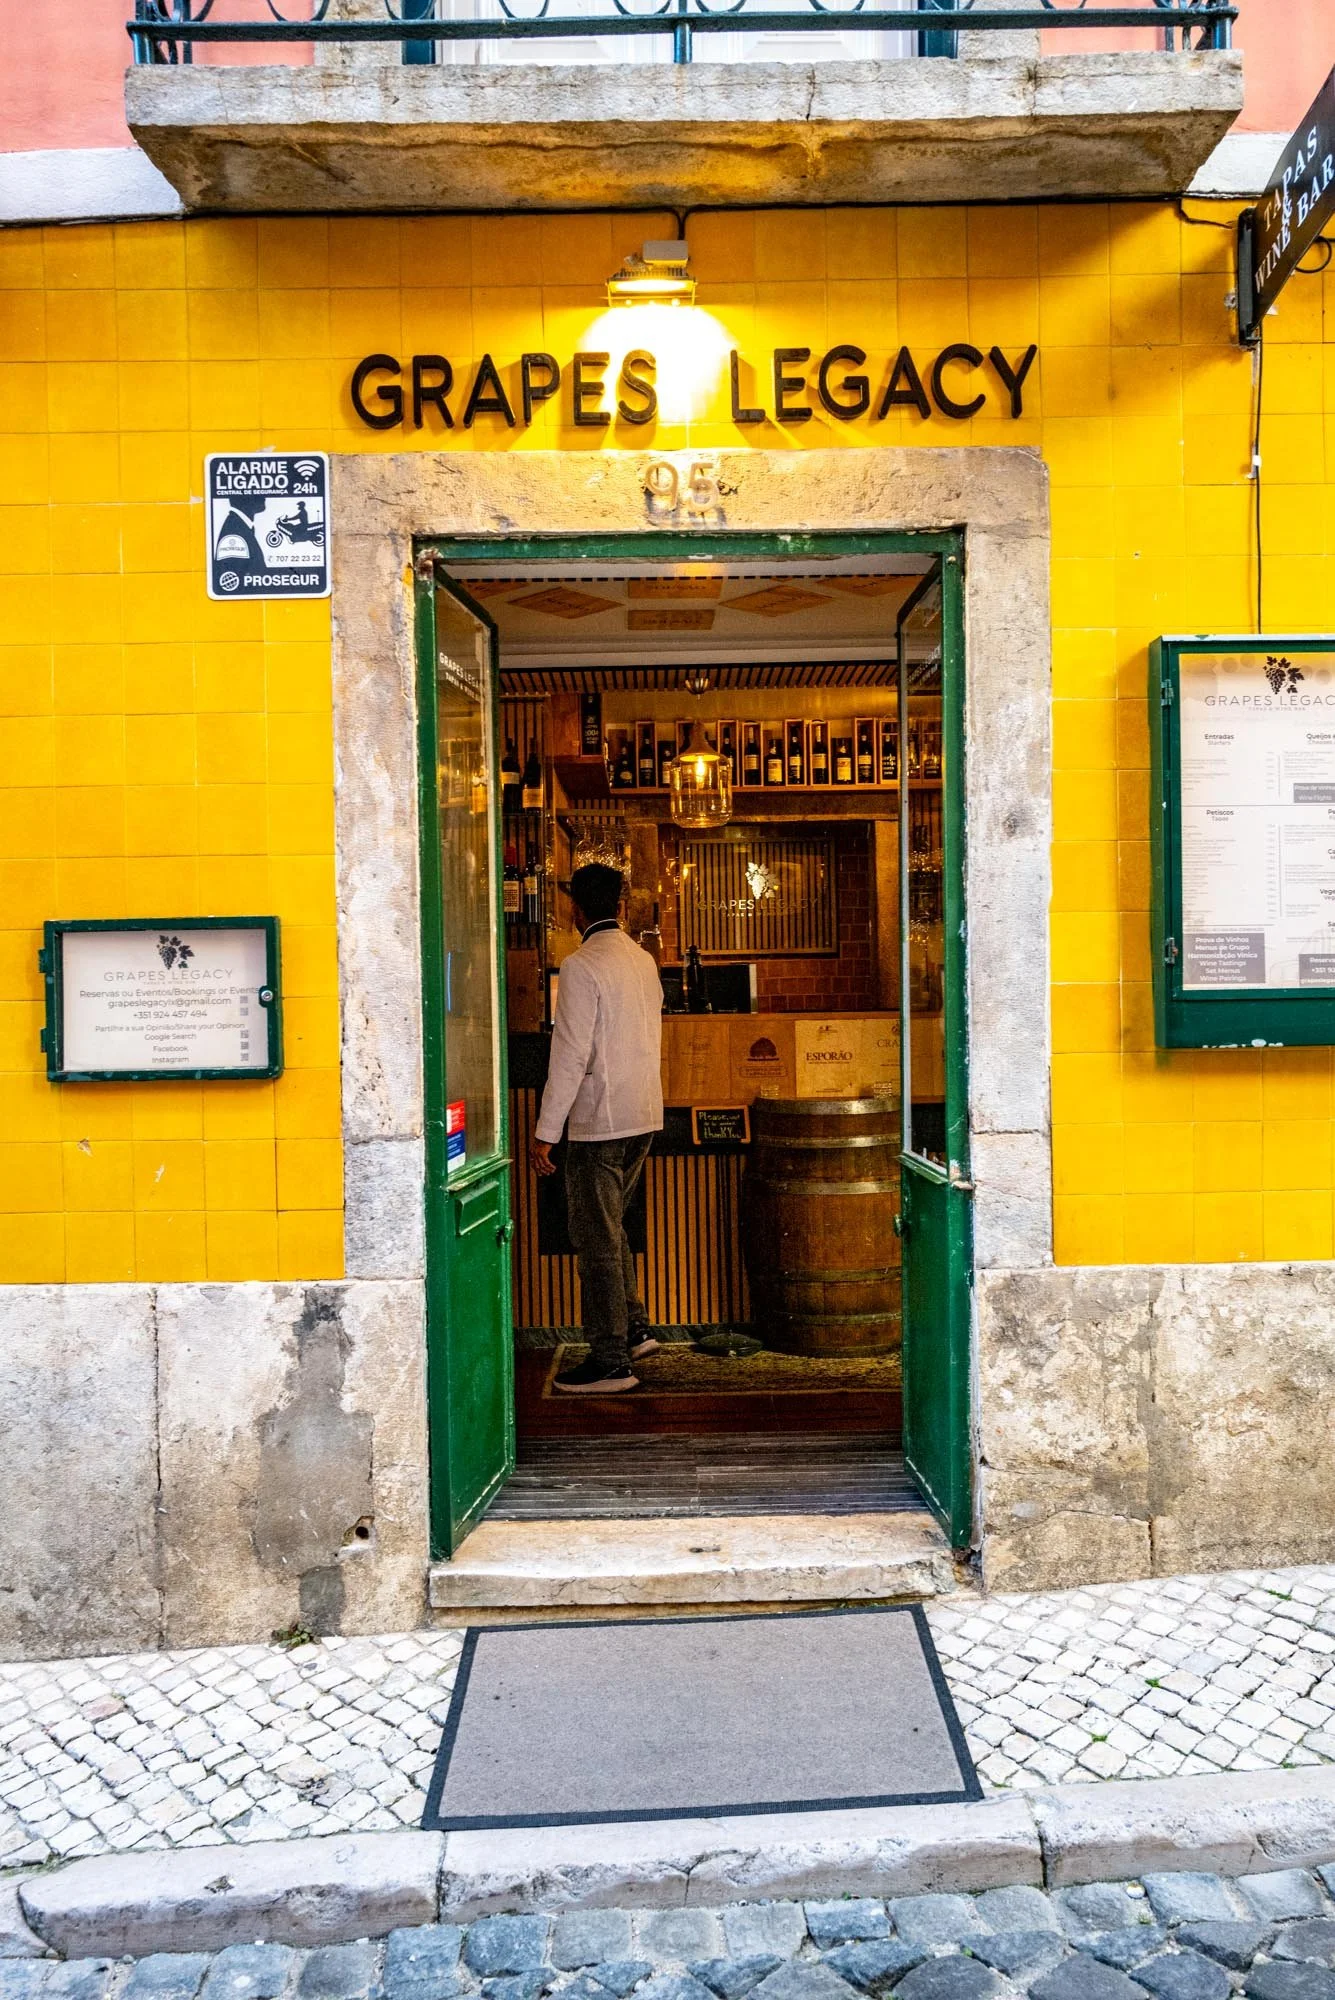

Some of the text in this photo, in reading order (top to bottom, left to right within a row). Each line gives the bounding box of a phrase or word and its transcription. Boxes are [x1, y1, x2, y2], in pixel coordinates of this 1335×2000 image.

[1263, 126, 1317, 232] TAPAS
[1254, 153, 1335, 294] WINE BAR
[350, 343, 1038, 430] GRAPES LEGACY
[216, 461, 288, 475] ALARME
[216, 475, 289, 490] LIGADO
[293, 483, 318, 494] 24h
[642, 459, 721, 513] 95
[243, 574, 320, 587] PROSEGUR
[1204, 695, 1335, 706] GRAPES LEGAC
[1306, 733, 1332, 741] Queijos
[698, 898, 755, 911] GRAPES
[103, 968, 233, 982] GRAPES LEGACY
[79, 990, 120, 998] Reservas
[198, 1023, 215, 1031] your
[215, 1022, 246, 1030] Opinion
[144, 1033, 171, 1041] Google
[152, 1057, 189, 1065] Instagram
[806, 1050, 853, 1062] ESPORÃO
